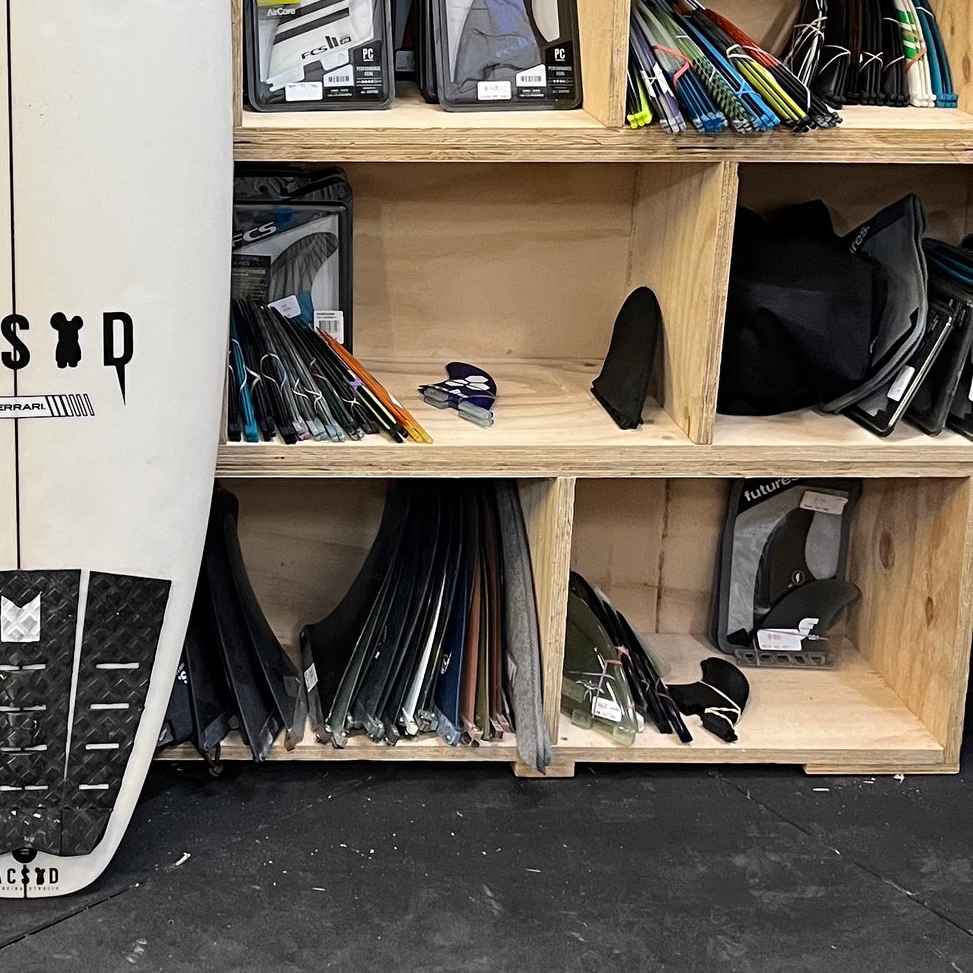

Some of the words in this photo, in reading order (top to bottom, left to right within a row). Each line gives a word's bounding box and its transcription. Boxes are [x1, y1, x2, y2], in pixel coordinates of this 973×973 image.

[266, 7, 297, 17] AirCore
[362, 48, 374, 60] PC
[554, 48, 566, 60] PC
[328, 75, 350, 83] MEDIUM
[520, 75, 542, 83] MEDIUM
